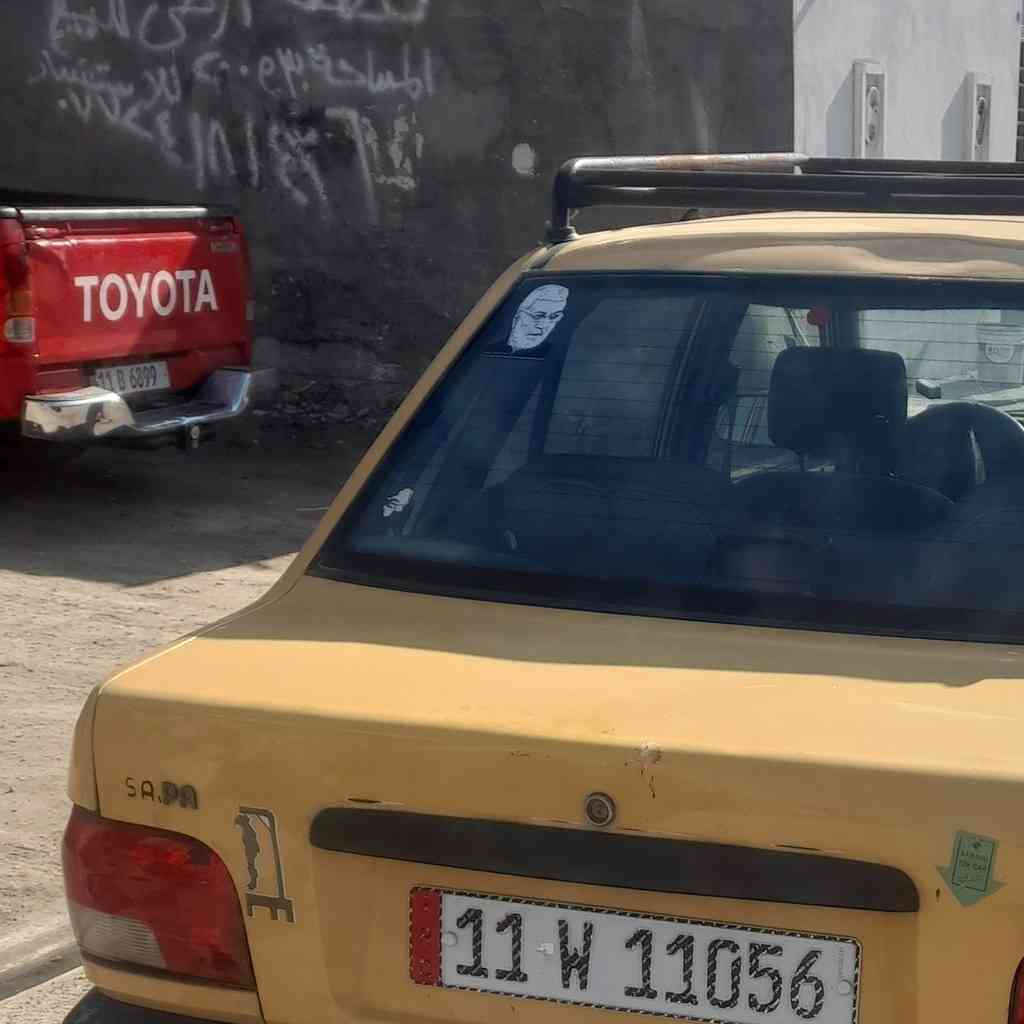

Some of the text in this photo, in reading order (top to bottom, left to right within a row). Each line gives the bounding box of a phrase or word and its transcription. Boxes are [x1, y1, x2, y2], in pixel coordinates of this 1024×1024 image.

[74, 269, 218, 322] TOYOTA
[456, 908, 528, 982] 11
[558, 919, 593, 991] W
[624, 929, 825, 1019] 11056
